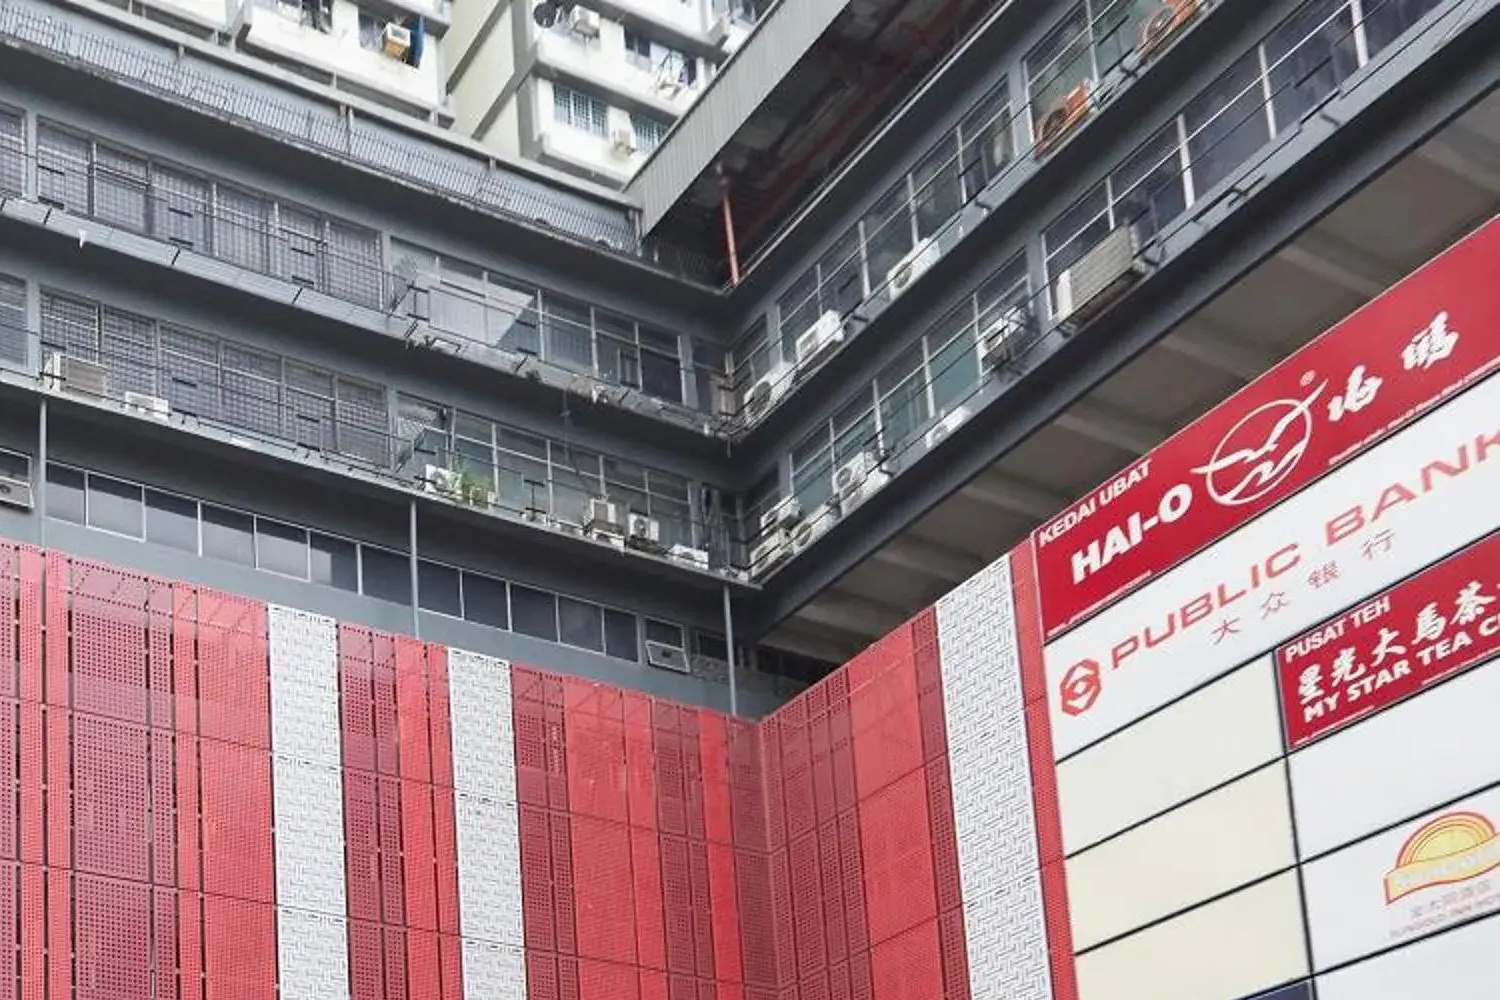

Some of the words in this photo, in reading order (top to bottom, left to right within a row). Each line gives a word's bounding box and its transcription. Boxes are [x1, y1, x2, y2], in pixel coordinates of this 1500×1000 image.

[1038, 495, 1098, 548] KEDAI
[1100, 458, 1152, 507] UBAT
[1071, 483, 1193, 586] HAI-O
[1110, 542, 1301, 671] PUBLIC
[1285, 618, 1347, 664] PUSAT
[1350, 596, 1391, 629] TEH
[1304, 692, 1340, 723] MY
[1348, 659, 1411, 702] STAR
[1416, 631, 1473, 666] TEA
[1478, 612, 1500, 636] C
